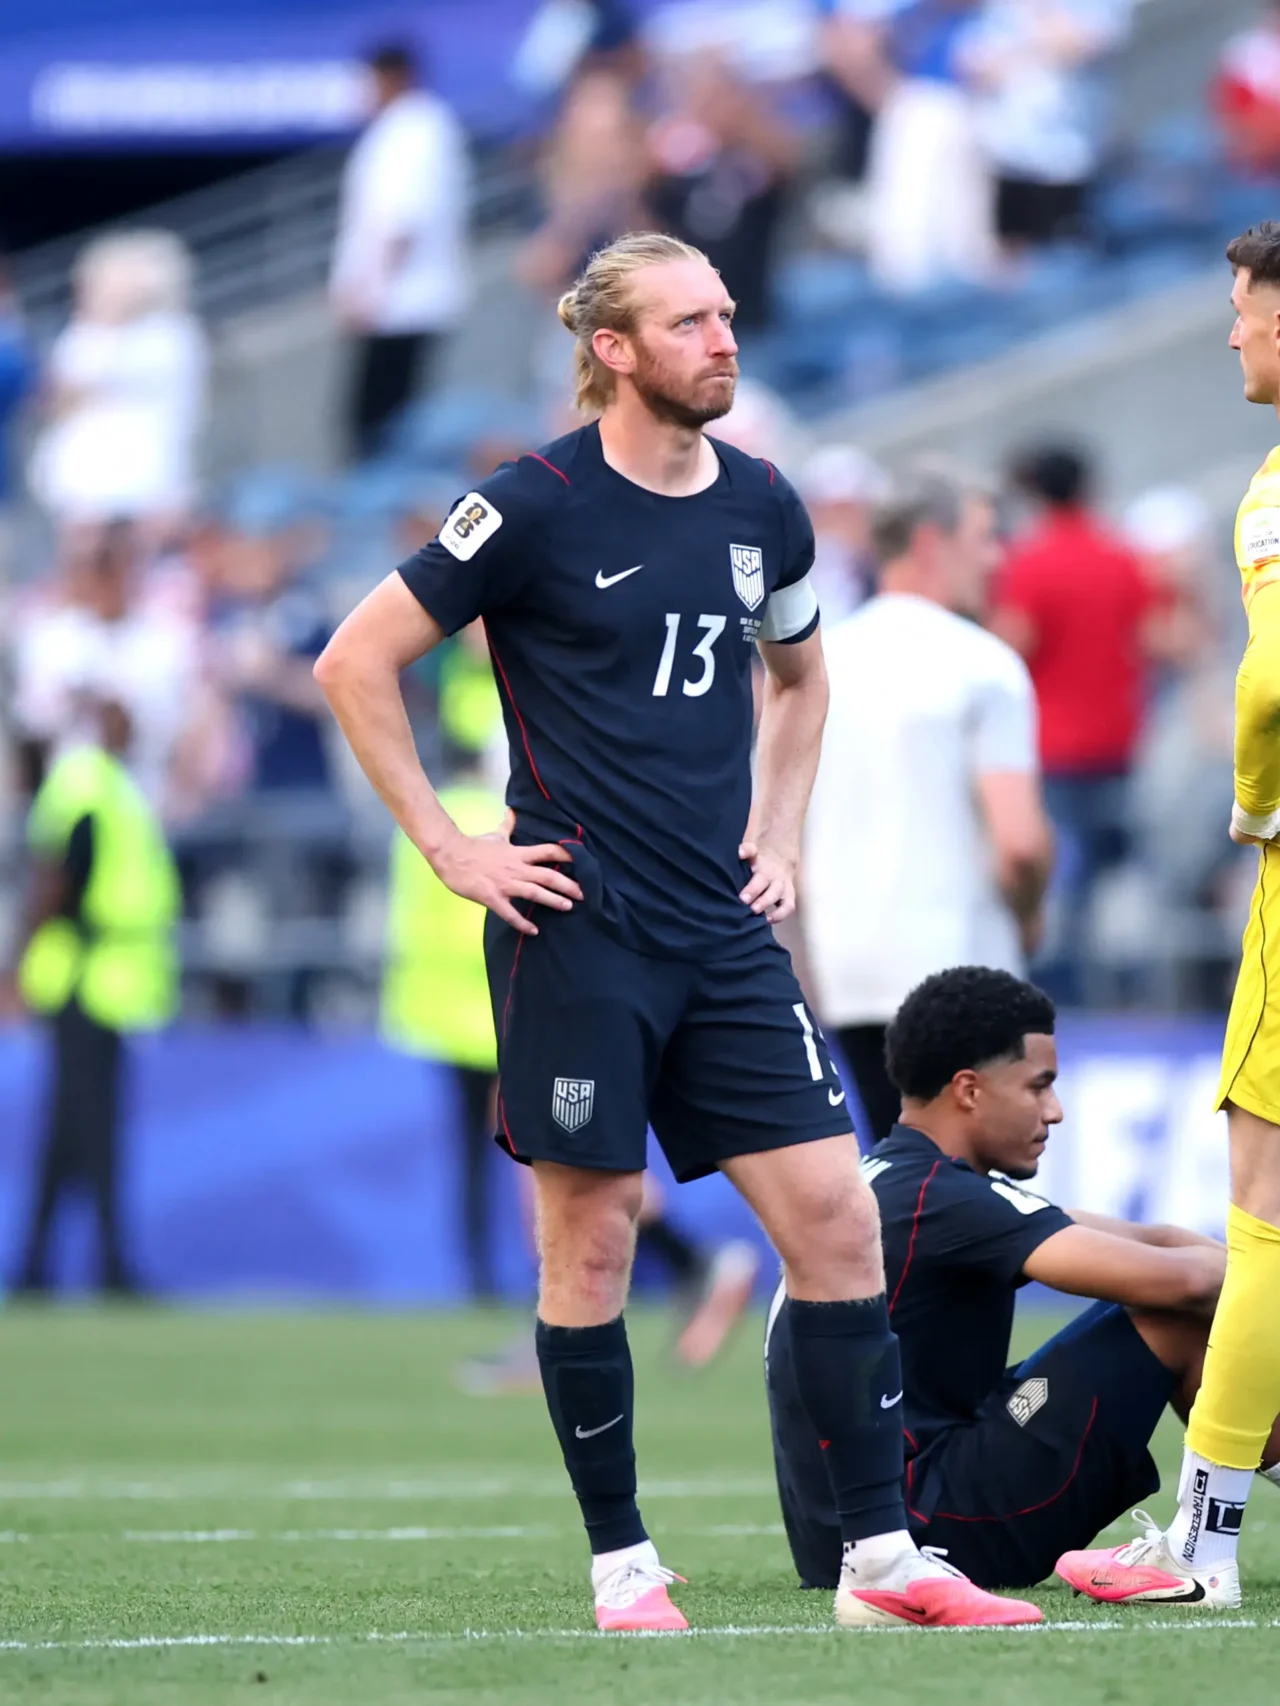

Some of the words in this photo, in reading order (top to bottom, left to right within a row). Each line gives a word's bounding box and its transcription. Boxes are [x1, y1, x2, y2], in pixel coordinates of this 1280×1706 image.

[732, 547, 761, 576] USA
[652, 612, 727, 697] 13
[792, 1002, 839, 1082] 1
[556, 1080, 591, 1103] USA
[1008, 1396, 1030, 1422] USA
[1181, 1495, 1205, 1563] TAPEDESIGN
